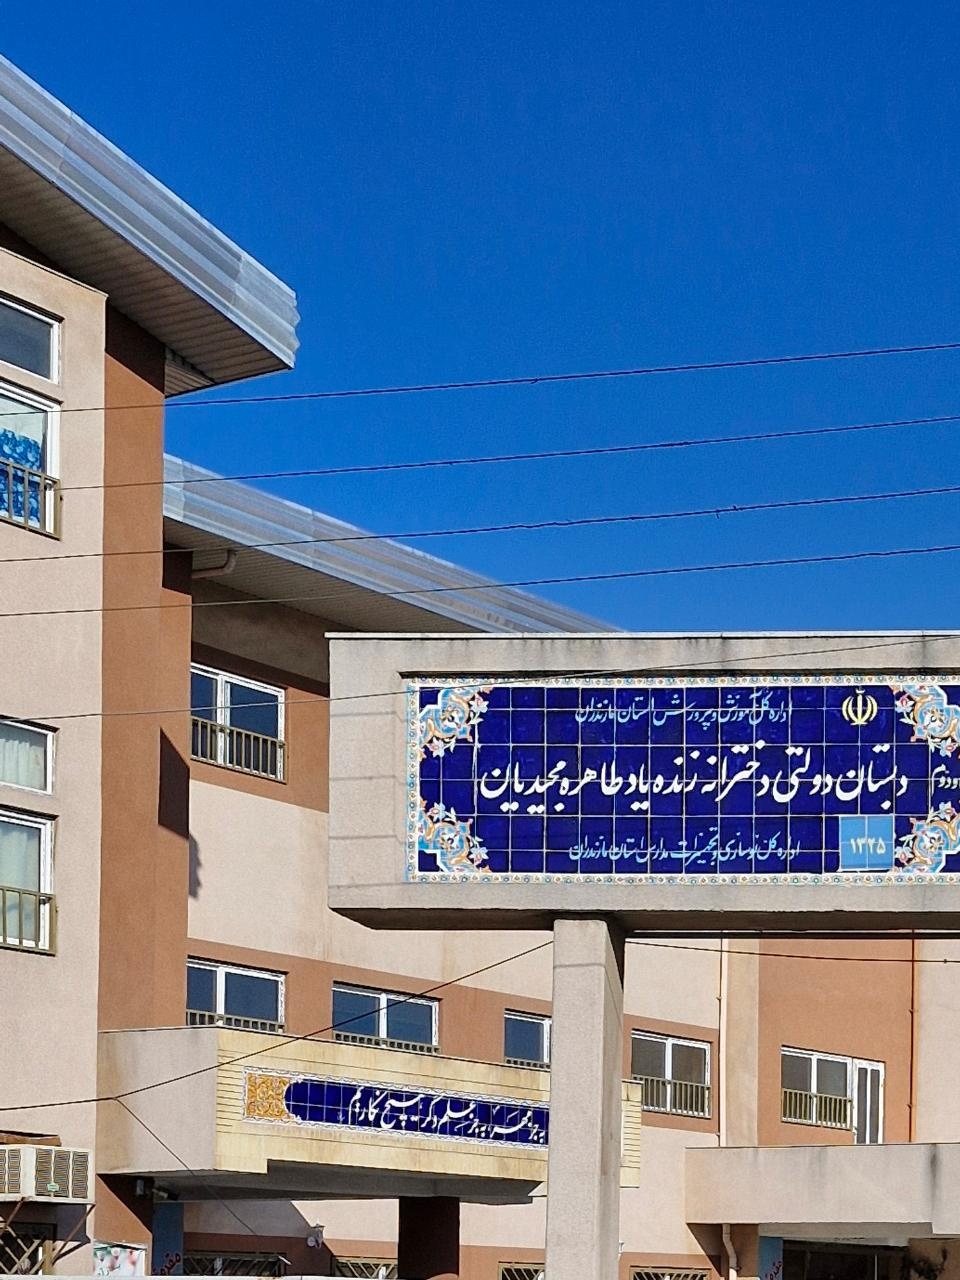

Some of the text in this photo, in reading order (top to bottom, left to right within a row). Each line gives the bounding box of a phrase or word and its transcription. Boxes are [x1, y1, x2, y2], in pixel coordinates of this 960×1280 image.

[574, 696, 615, 723] مازندران
[618, 695, 655, 724] استان
[653, 694, 712, 730] پرورش
[719, 691, 761, 723] آموزش
[750, 690, 773, 725] کل
[768, 700, 792, 723] اداره
[479, 739, 908, 814] دبستان دولتی دخترانه زنده یاد طاهره مجیدیان
[931, 763, 951, 797] دوم
[568, 834, 608, 861] مازندران
[608, 837, 643, 862] استان
[670, 827, 719, 866] تجهیزات
[718, 832, 760, 862] نوسازی
[757, 831, 781, 861] کل
[777, 836, 800, 860] اداره
